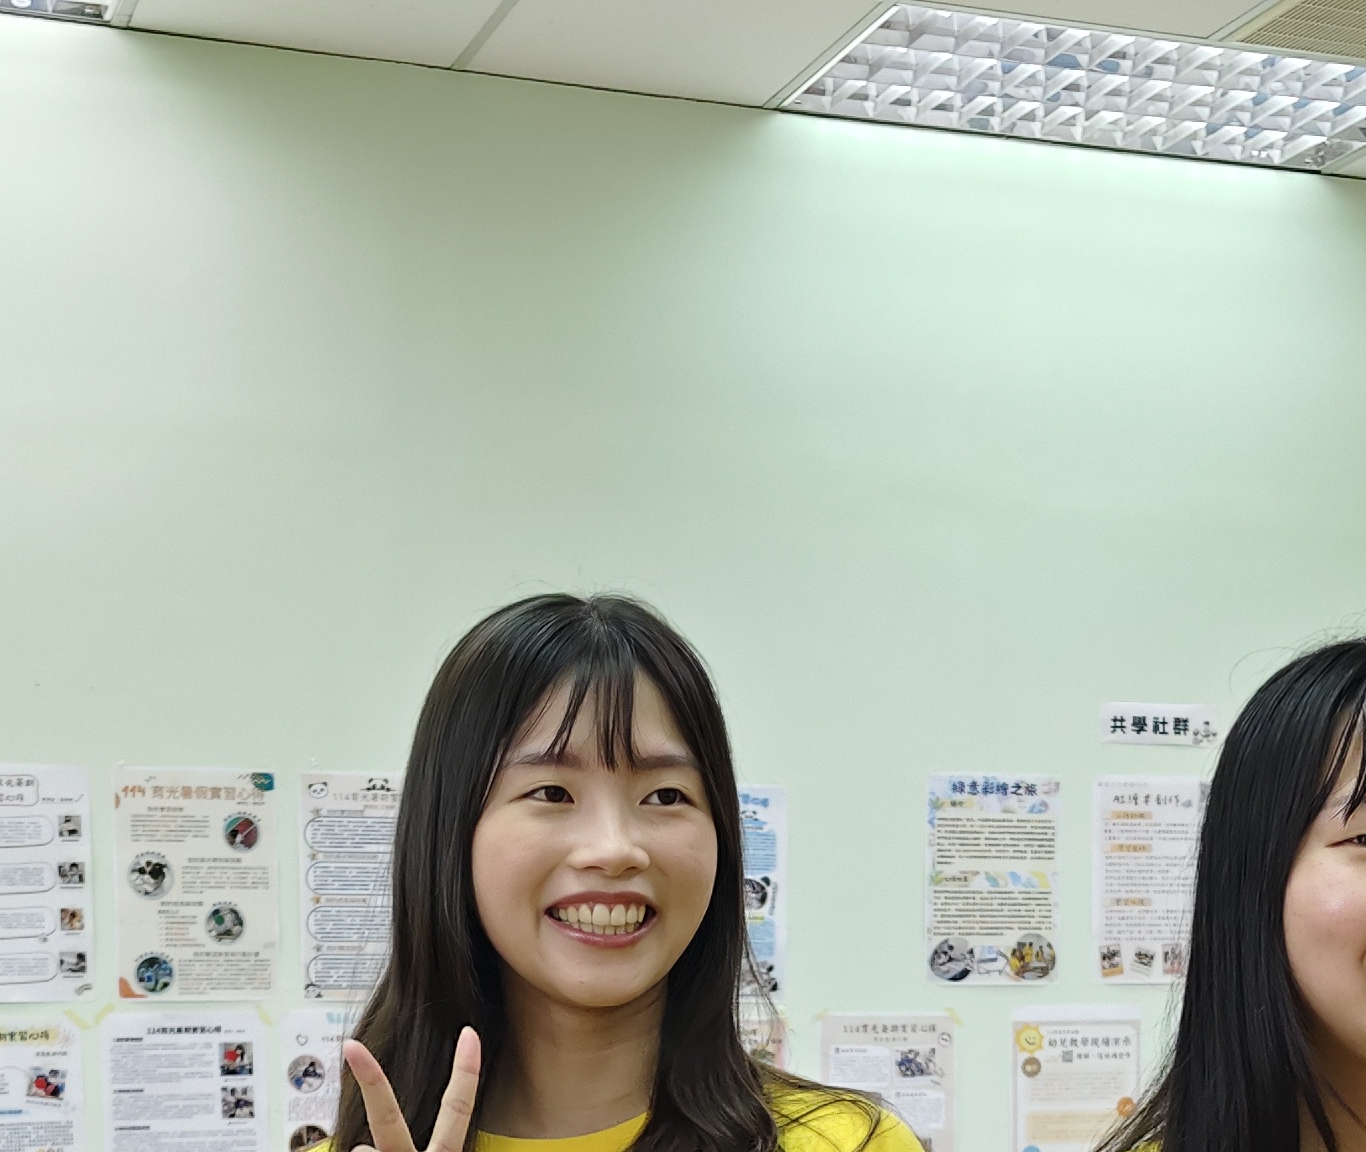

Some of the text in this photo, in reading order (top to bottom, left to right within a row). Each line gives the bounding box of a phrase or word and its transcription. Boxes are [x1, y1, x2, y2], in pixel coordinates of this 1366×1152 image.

[1109, 715, 1191, 735] 共學社群
[951, 780, 1039, 797] 綠意彩繪之旅
